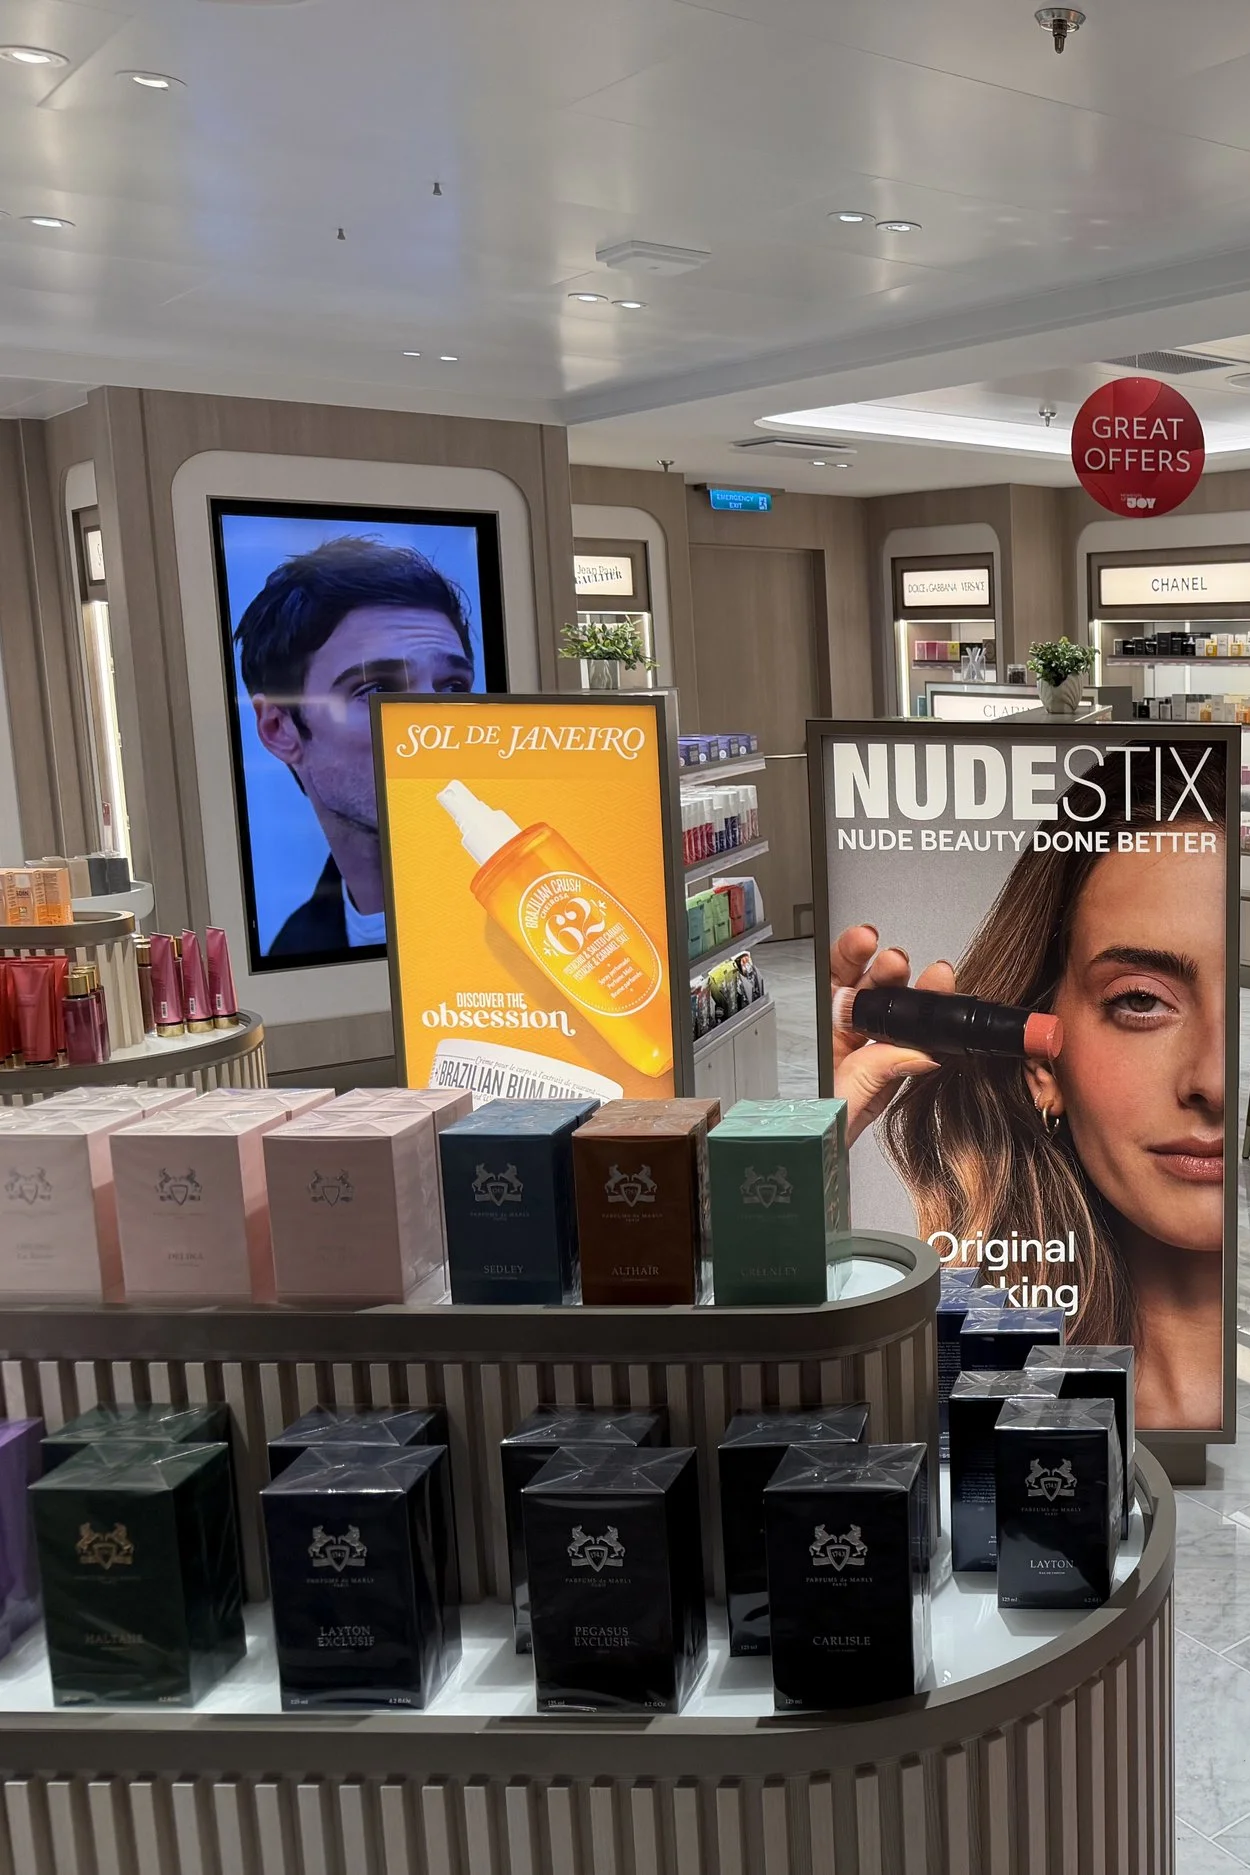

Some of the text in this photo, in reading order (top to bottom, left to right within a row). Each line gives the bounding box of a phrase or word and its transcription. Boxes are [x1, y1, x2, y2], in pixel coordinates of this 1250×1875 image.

[1092, 416, 1184, 441] GREAT
[1084, 448, 1191, 472] OFFERS
[716, 493, 754, 502] EMERGENCY
[1126, 497, 1156, 509] JOY
[577, 565, 597, 575] Jean
[961, 581, 985, 592] VERSACE
[1151, 577, 1208, 593] CHANEL
[396, 724, 646, 760] SOL DE JANEIRO
[832, 742, 1214, 822] NUDESTIX
[838, 829, 1217, 853] NUDE BEAUTY DONE BETTER
[524, 878, 582, 929] BRAZILIAN CRUSH
[540, 892, 570, 919] CHEIROSA
[545, 897, 606, 956] 62
[456, 992, 525, 1008] DISCOVER THE
[421, 1002, 577, 1037] obsession
[438, 1060, 505, 1097] BRAZILIAN
[506, 1073, 545, 1099] BUM
[926, 1231, 1075, 1271] Original
[483, 1264, 524, 1274] SEDLEY
[611, 1265, 660, 1276] ALTHAÏR
[1030, 1560, 1075, 1569] LAYTON
[320, 1626, 371, 1637] LAYTON
[575, 1626, 629, 1637] PEGASUS
[317, 1636, 375, 1647] EXCLUSIF
[574, 1636, 631, 1647] EXCLUSIF
[812, 1636, 872, 1646] CARLISLE
